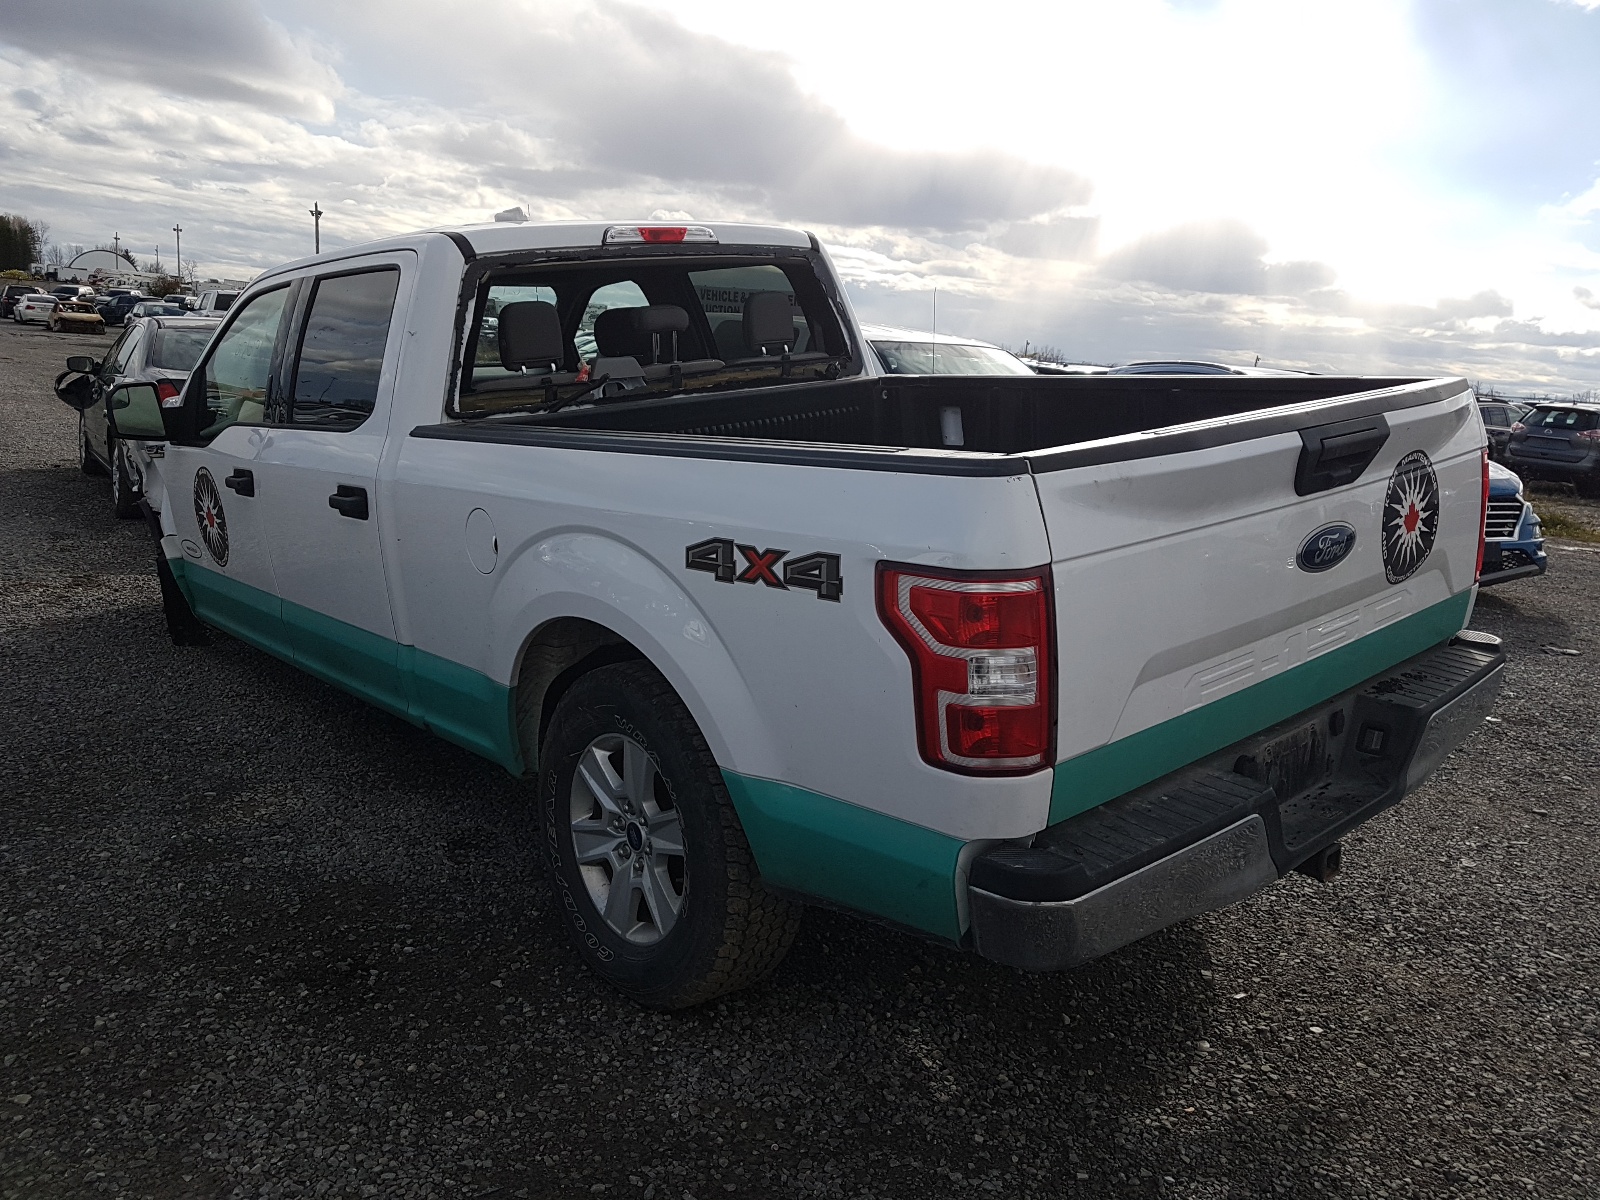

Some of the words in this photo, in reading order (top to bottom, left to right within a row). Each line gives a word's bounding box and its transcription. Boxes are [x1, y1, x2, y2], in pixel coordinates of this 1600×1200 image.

[700, 288, 739, 303] VEHICLE
[702, 303, 741, 313] UCTION
[1315, 533, 1347, 563] Ford
[1386, 548, 1430, 583] CONSTRUCTION
[547, 769, 615, 962] GOODYEAR
